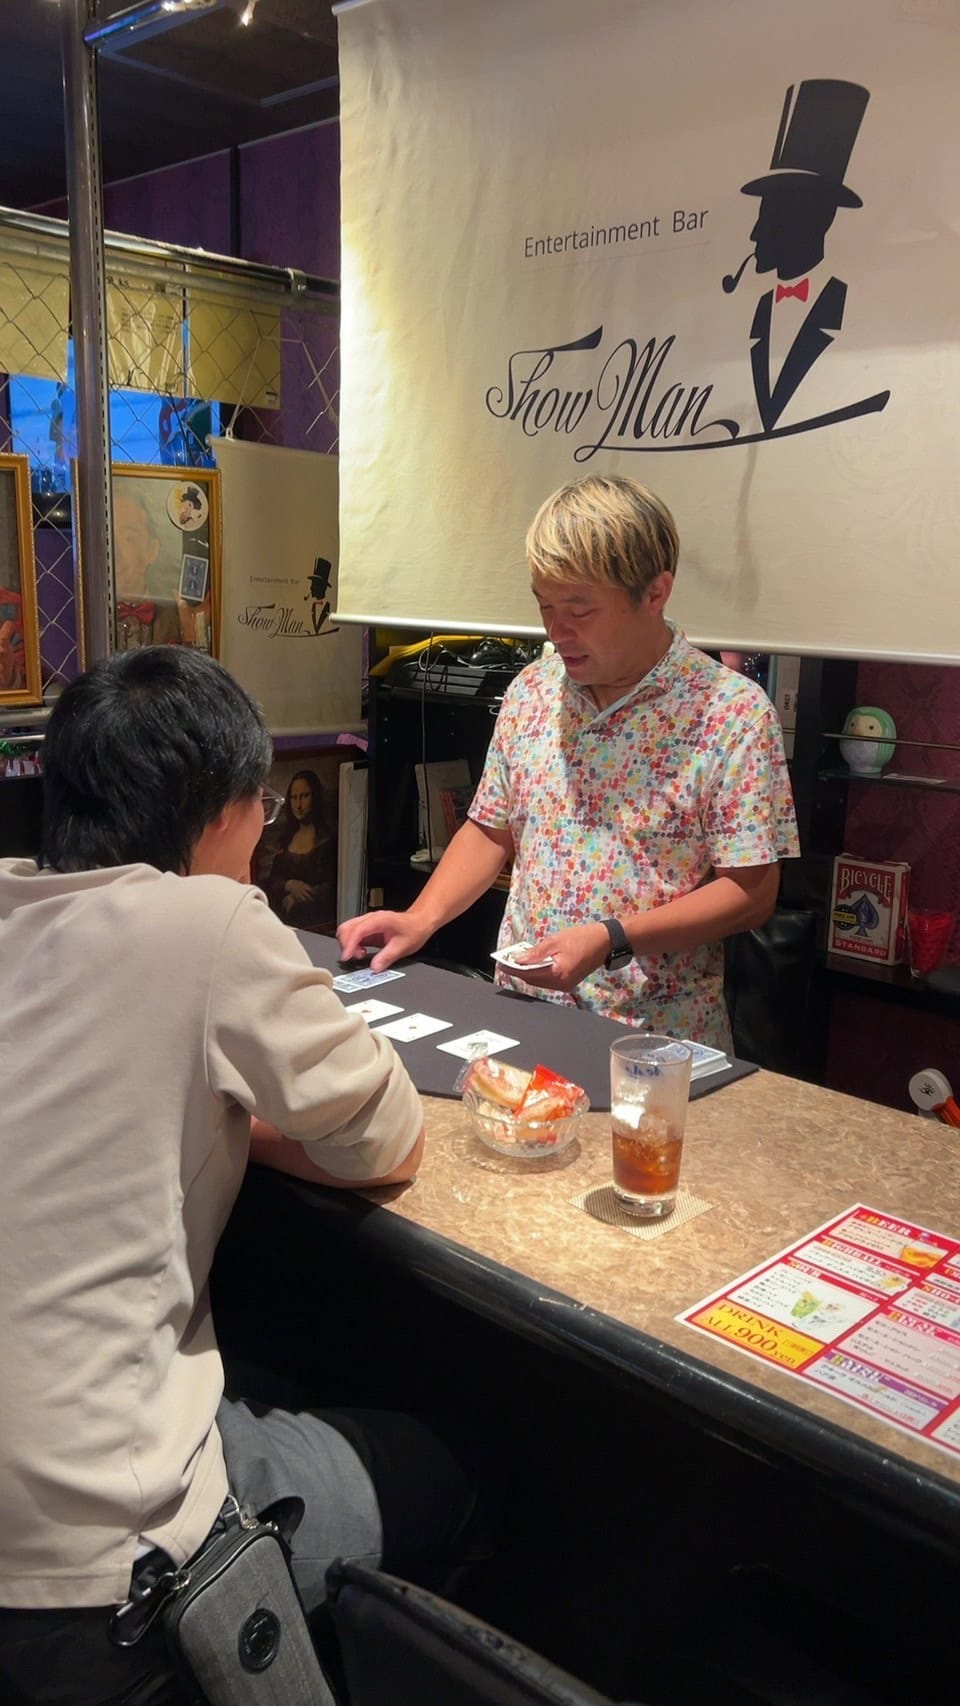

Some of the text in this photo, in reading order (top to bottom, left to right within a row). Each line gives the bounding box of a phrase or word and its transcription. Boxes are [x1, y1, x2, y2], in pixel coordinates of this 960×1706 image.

[524, 209, 710, 258] Entertainment Bar
[485, 326, 604, 437] Show
[238, 603, 275, 631] Show
[840, 867, 892, 904] BICYCLE
[834, 940, 888, 957] STANDARD
[703, 1315, 734, 1336] ALL
[735, 1327, 778, 1352] 900
[717, 1303, 780, 1337] DRINK
